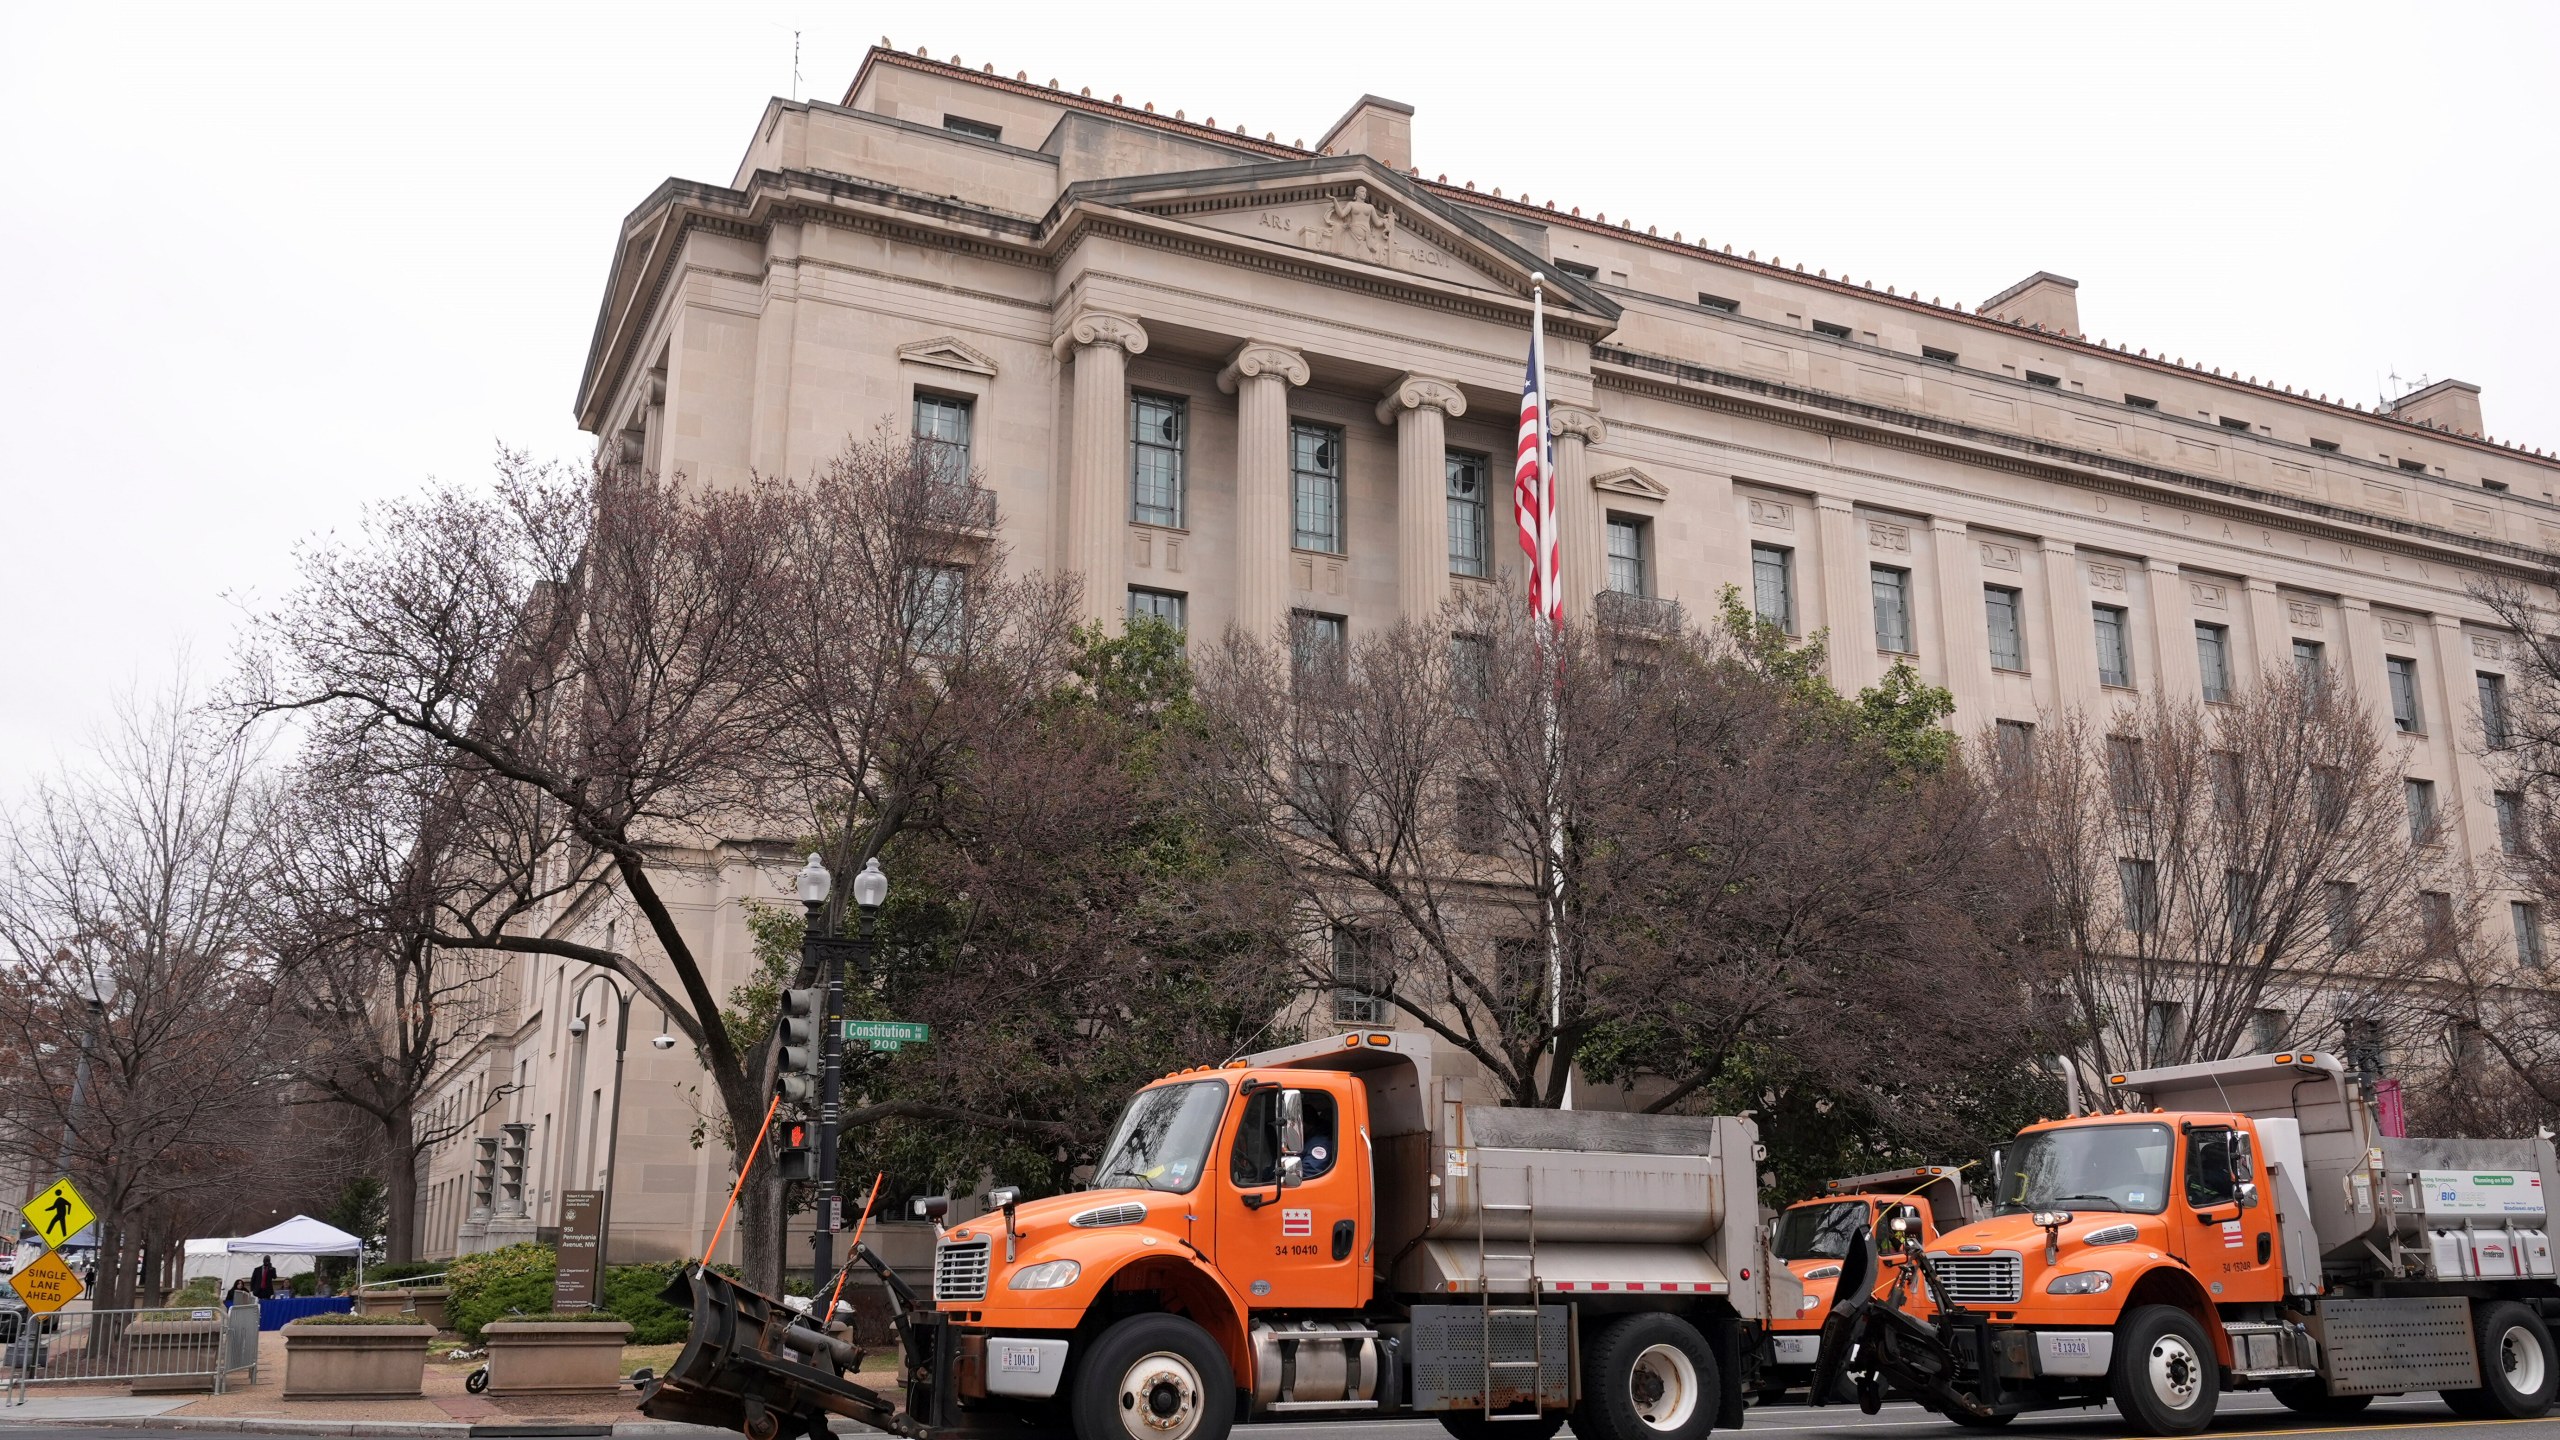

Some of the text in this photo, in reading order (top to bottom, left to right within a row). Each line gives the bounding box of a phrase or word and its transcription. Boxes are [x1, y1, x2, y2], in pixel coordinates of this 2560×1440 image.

[1259, 212, 1291, 231] ARS
[849, 1023, 911, 1039] Constitution
[874, 1040, 898, 1049] 900
[1275, 1245, 1318, 1255] 34 10410
[2222, 1261, 2251, 1273] 34 13248
[28, 1269, 67, 1281] SINGLE
[30, 1280, 60, 1291] LANE
[26, 1291, 62, 1302] AHEAD
[2063, 1342, 2086, 1353] 13248
[1013, 1354, 1035, 1366] 10410
